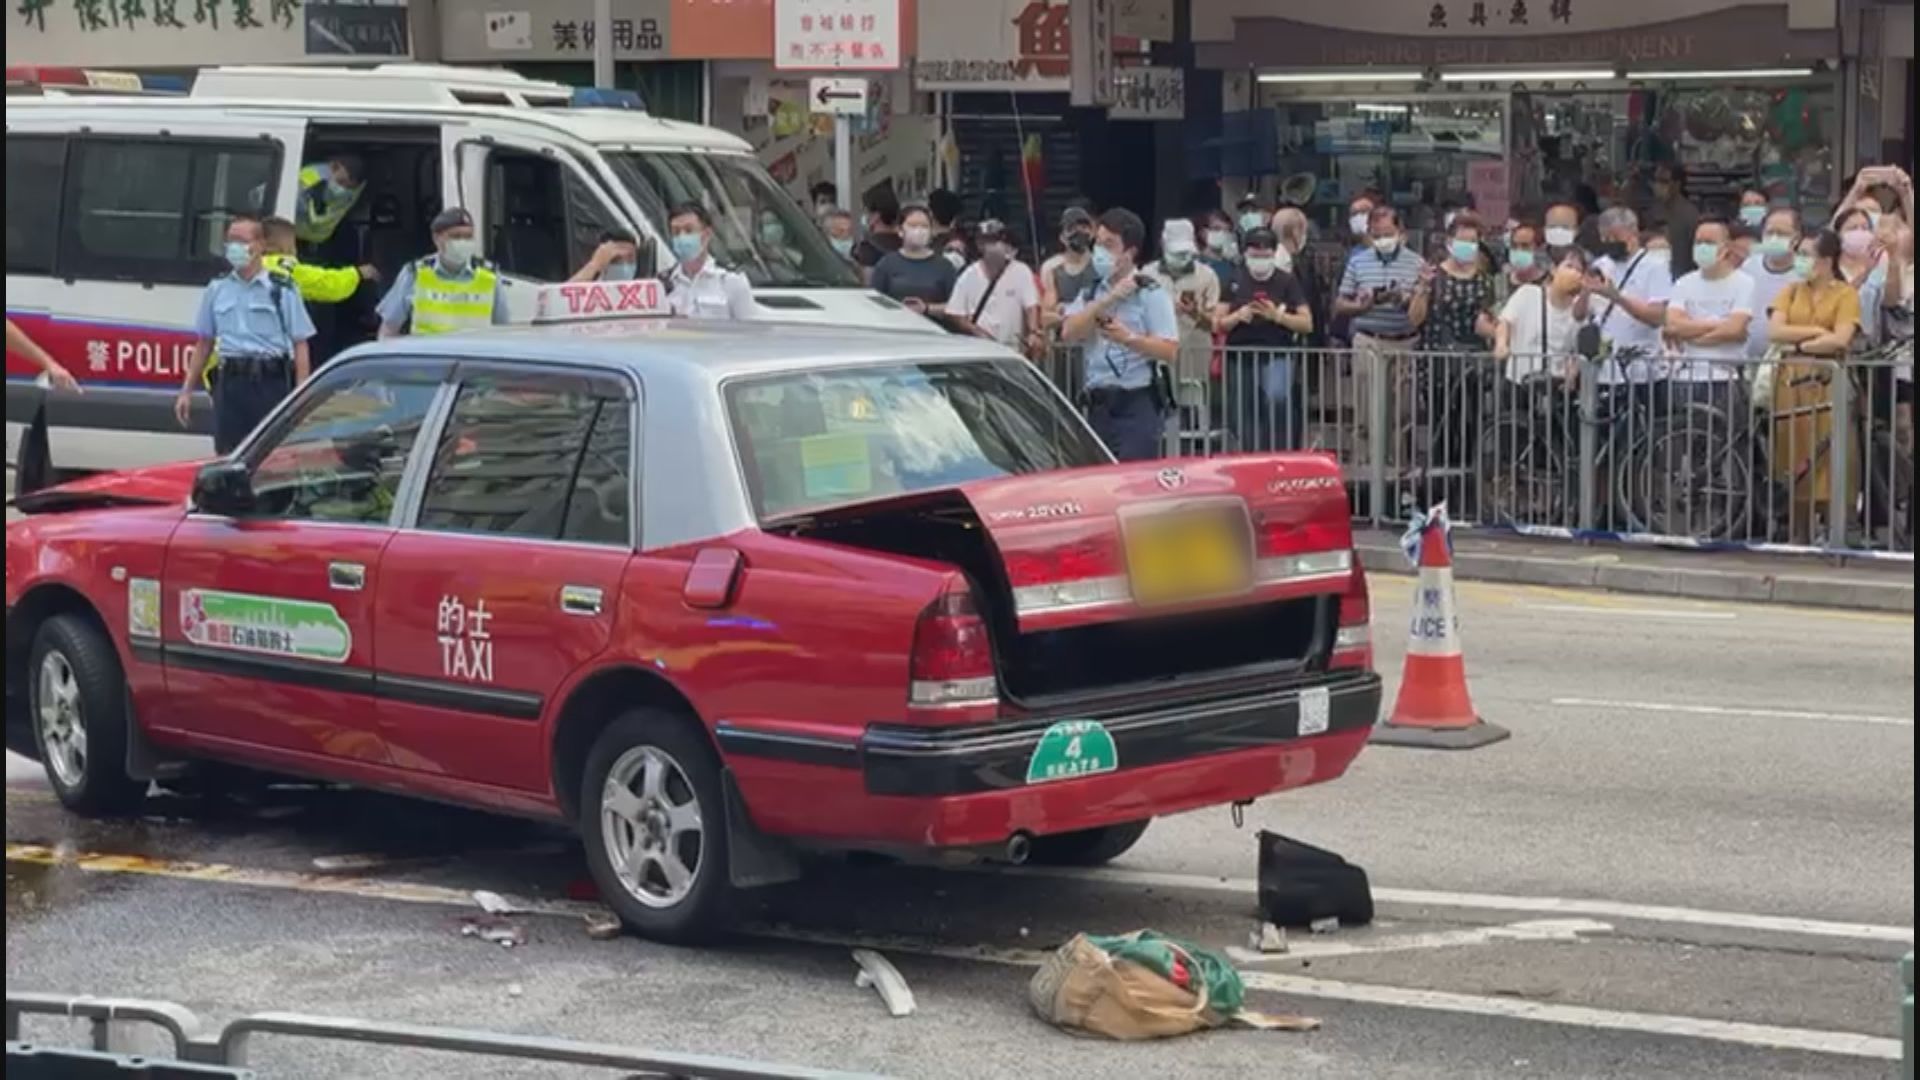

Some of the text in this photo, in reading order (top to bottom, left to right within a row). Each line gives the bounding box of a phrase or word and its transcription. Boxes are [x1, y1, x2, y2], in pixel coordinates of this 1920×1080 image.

[561, 284, 657, 313] TAXI
[117, 340, 198, 375] POLIC
[438, 595, 493, 639] 的士
[438, 636, 493, 682] TAXI
[1064, 736, 1082, 759] 4
